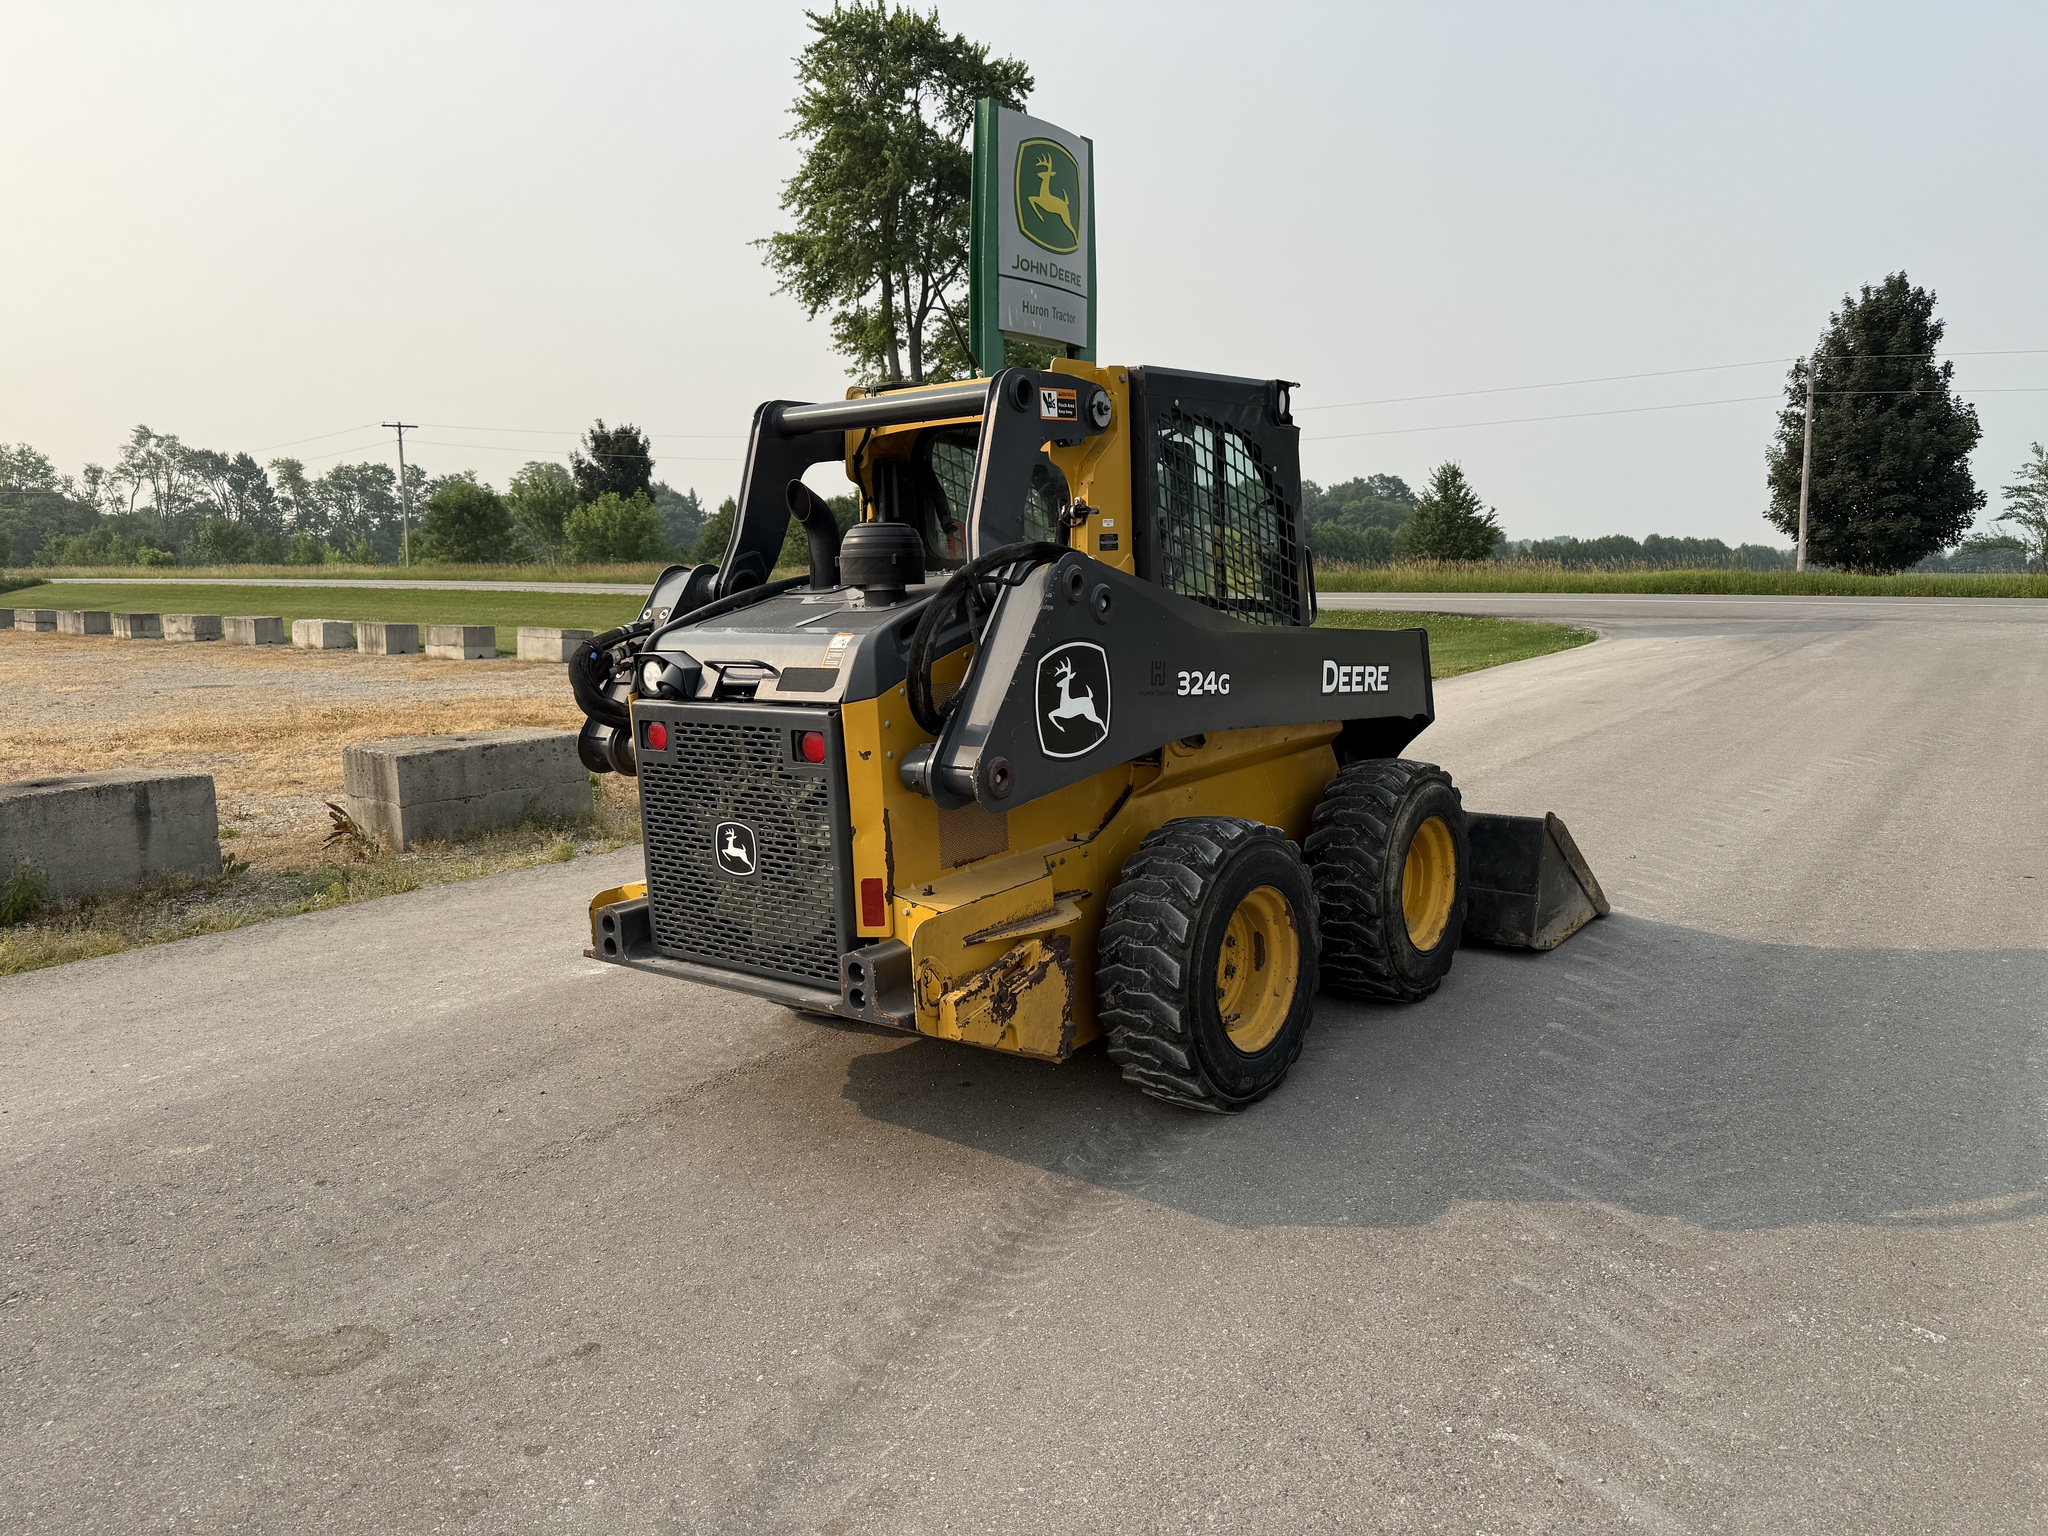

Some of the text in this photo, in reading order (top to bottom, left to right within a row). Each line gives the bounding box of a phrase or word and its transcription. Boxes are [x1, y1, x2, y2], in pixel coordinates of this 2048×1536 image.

[1012, 254, 1081, 287] JOHN DEERE
[1022, 300, 1076, 325] Huron Tractor
[1177, 671, 1230, 696] 324G
[1321, 659, 1389, 693] DEERE
